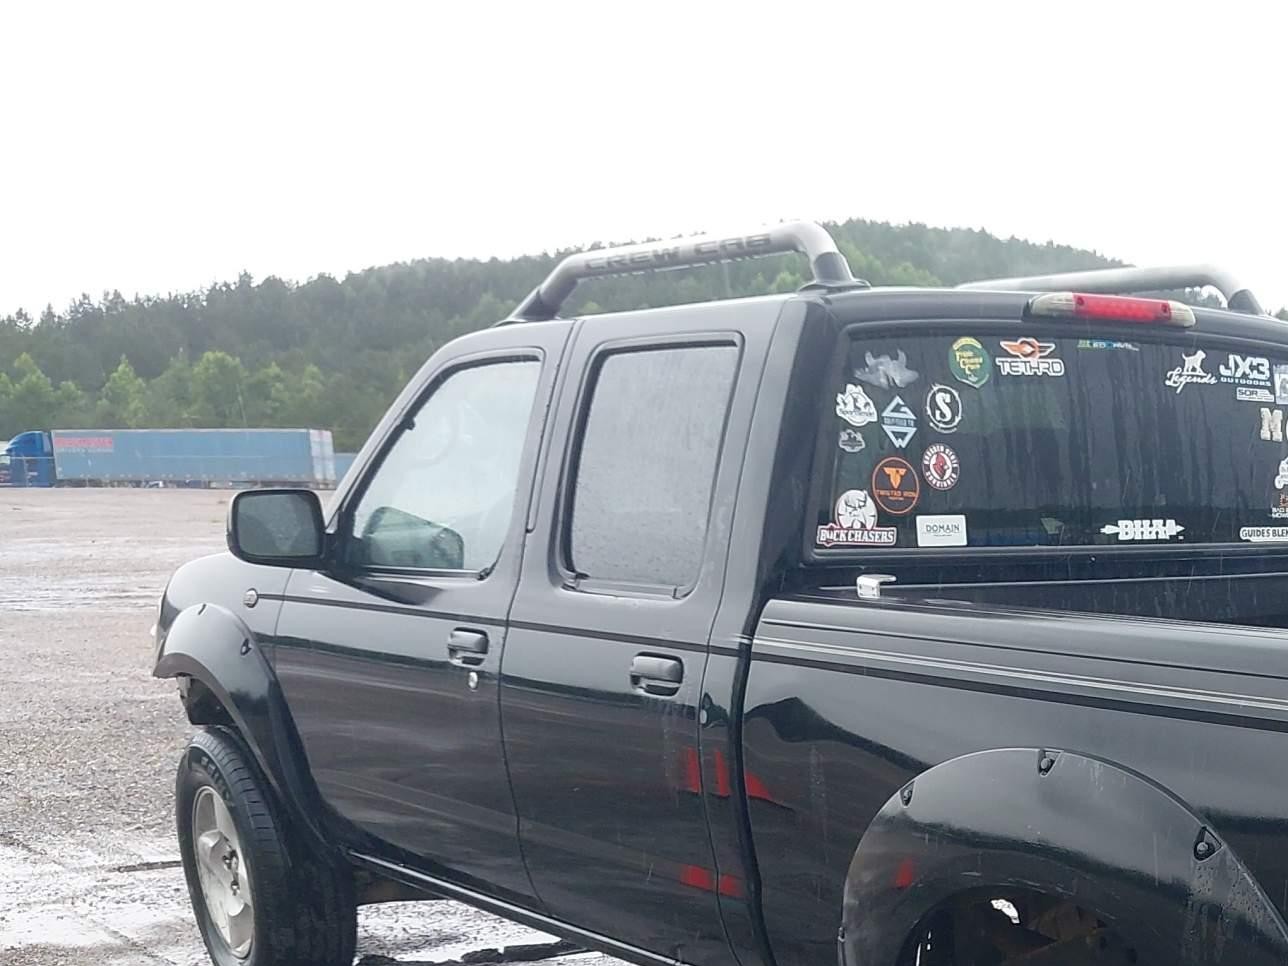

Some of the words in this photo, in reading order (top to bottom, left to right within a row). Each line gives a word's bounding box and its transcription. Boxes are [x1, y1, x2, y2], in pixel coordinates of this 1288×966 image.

[584, 246, 680, 270] CREW
[694, 233, 771, 256] CAB
[995, 357, 1065, 376] TETHRD
[1219, 354, 1270, 380] JX3
[1165, 367, 1218, 394] Legends
[1220, 376, 1272, 387] OUTDOORS
[935, 392, 952, 422] S
[1260, 407, 1283, 442] M
[848, 529, 894, 543] CHASERS
[925, 524, 960, 533] DOMAIN
[1241, 528, 1271, 538] GUIDES
